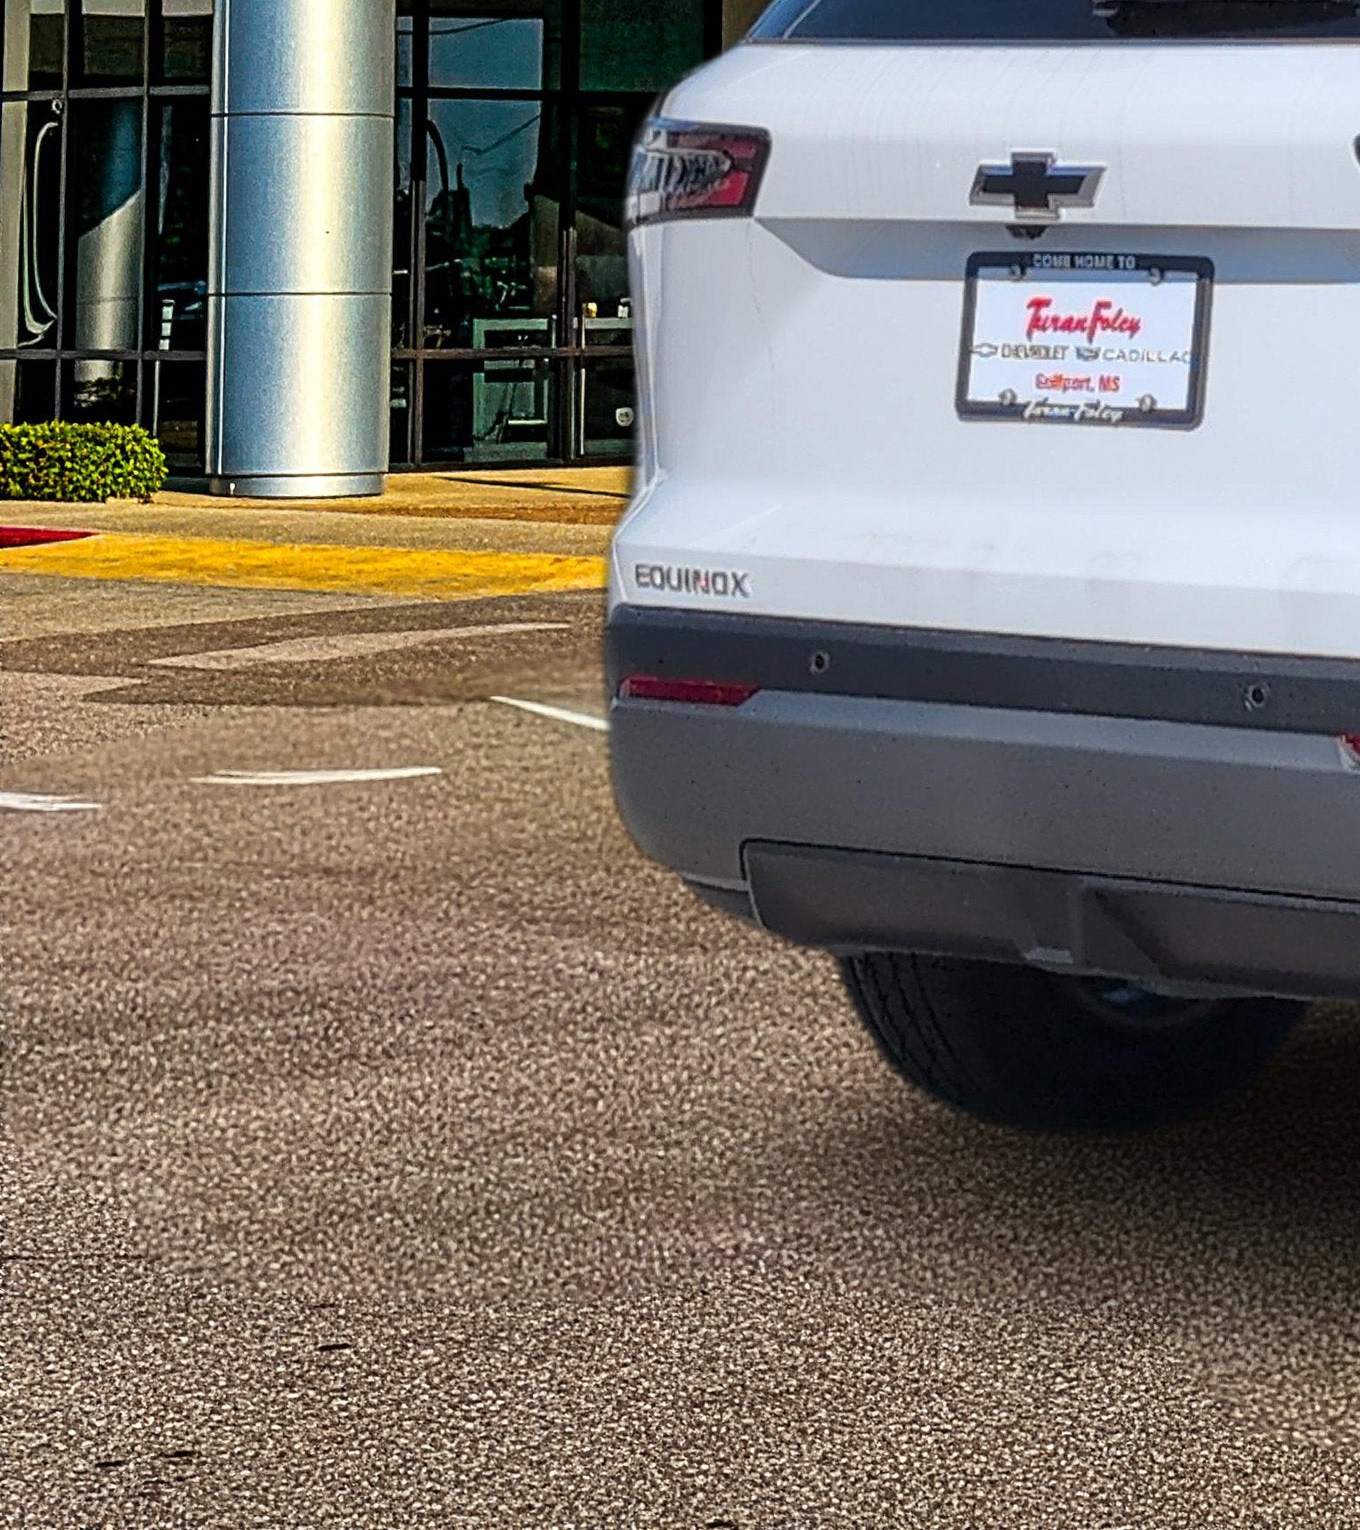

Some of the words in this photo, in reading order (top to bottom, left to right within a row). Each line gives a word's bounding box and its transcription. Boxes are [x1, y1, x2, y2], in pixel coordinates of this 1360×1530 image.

[1033, 253, 1071, 269] COME
[1074, 255, 1115, 269] HOME
[1117, 255, 1136, 270] TO
[634, 564, 750, 599] EQUINOX
